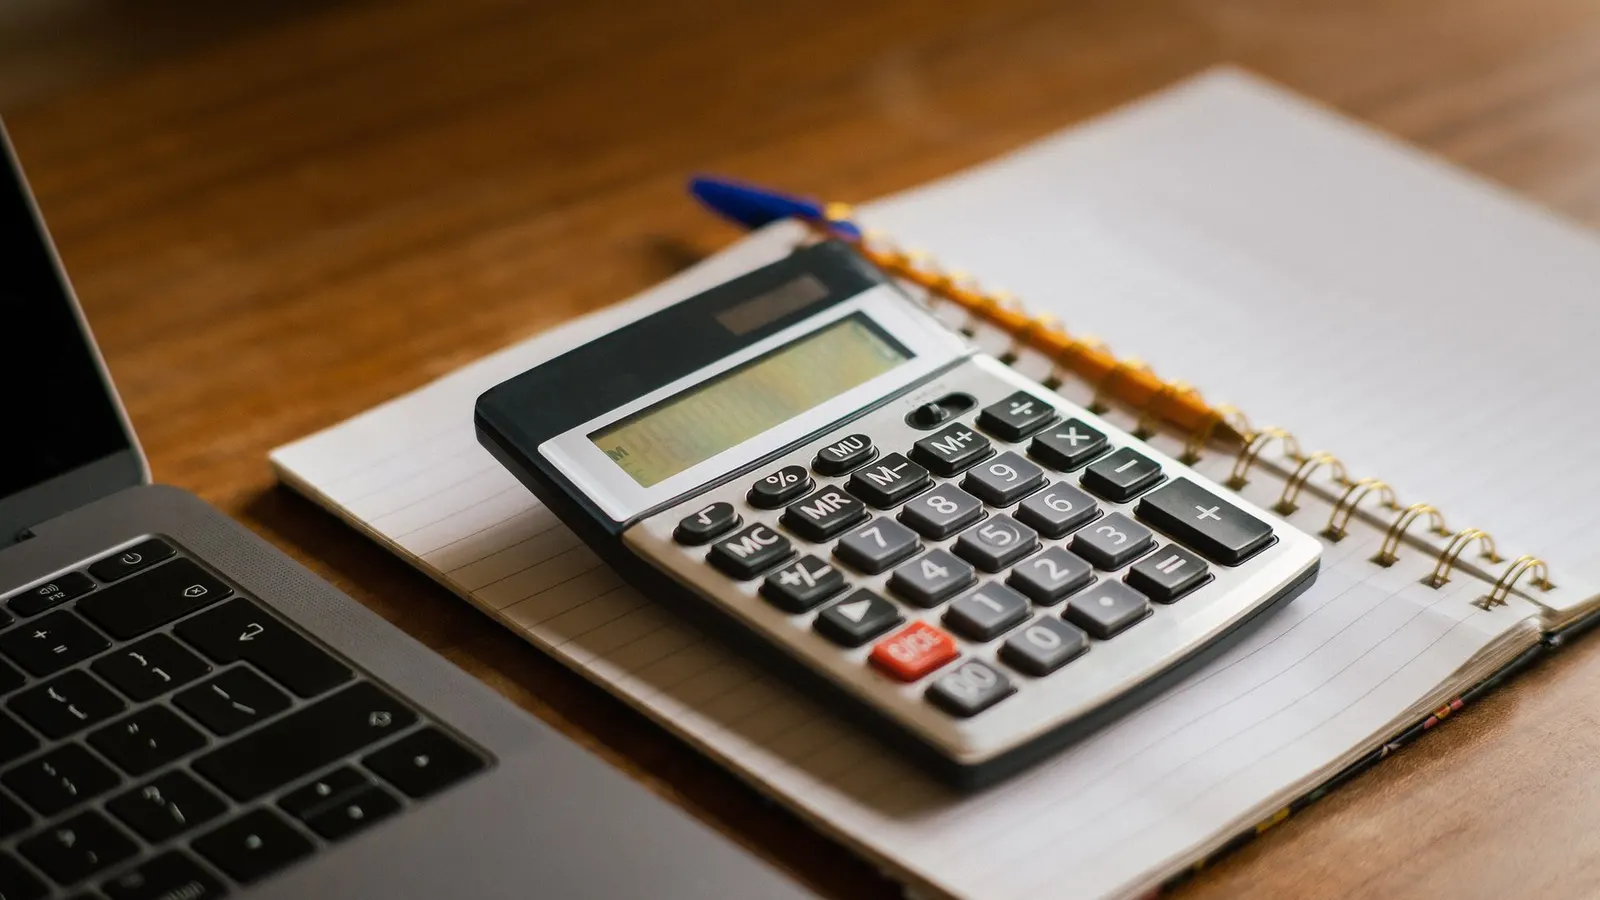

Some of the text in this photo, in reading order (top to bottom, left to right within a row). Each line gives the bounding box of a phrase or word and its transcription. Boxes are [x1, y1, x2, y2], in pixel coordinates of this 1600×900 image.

[828, 437, 864, 458] MU
[931, 429, 973, 455] M+
[766, 473, 798, 488] %
[989, 464, 1018, 482] 9
[800, 492, 851, 520] MR
[926, 496, 958, 514] 8
[1043, 493, 1073, 512] 6
[726, 527, 779, 559] MC
[859, 527, 888, 548] 7
[980, 525, 1012, 545] 5
[1095, 526, 1127, 545] 3
[920, 559, 949, 581] 4
[1034, 559, 1069, 582] 2
[972, 593, 1004, 613] 1
[1026, 628, 1061, 649] 0
